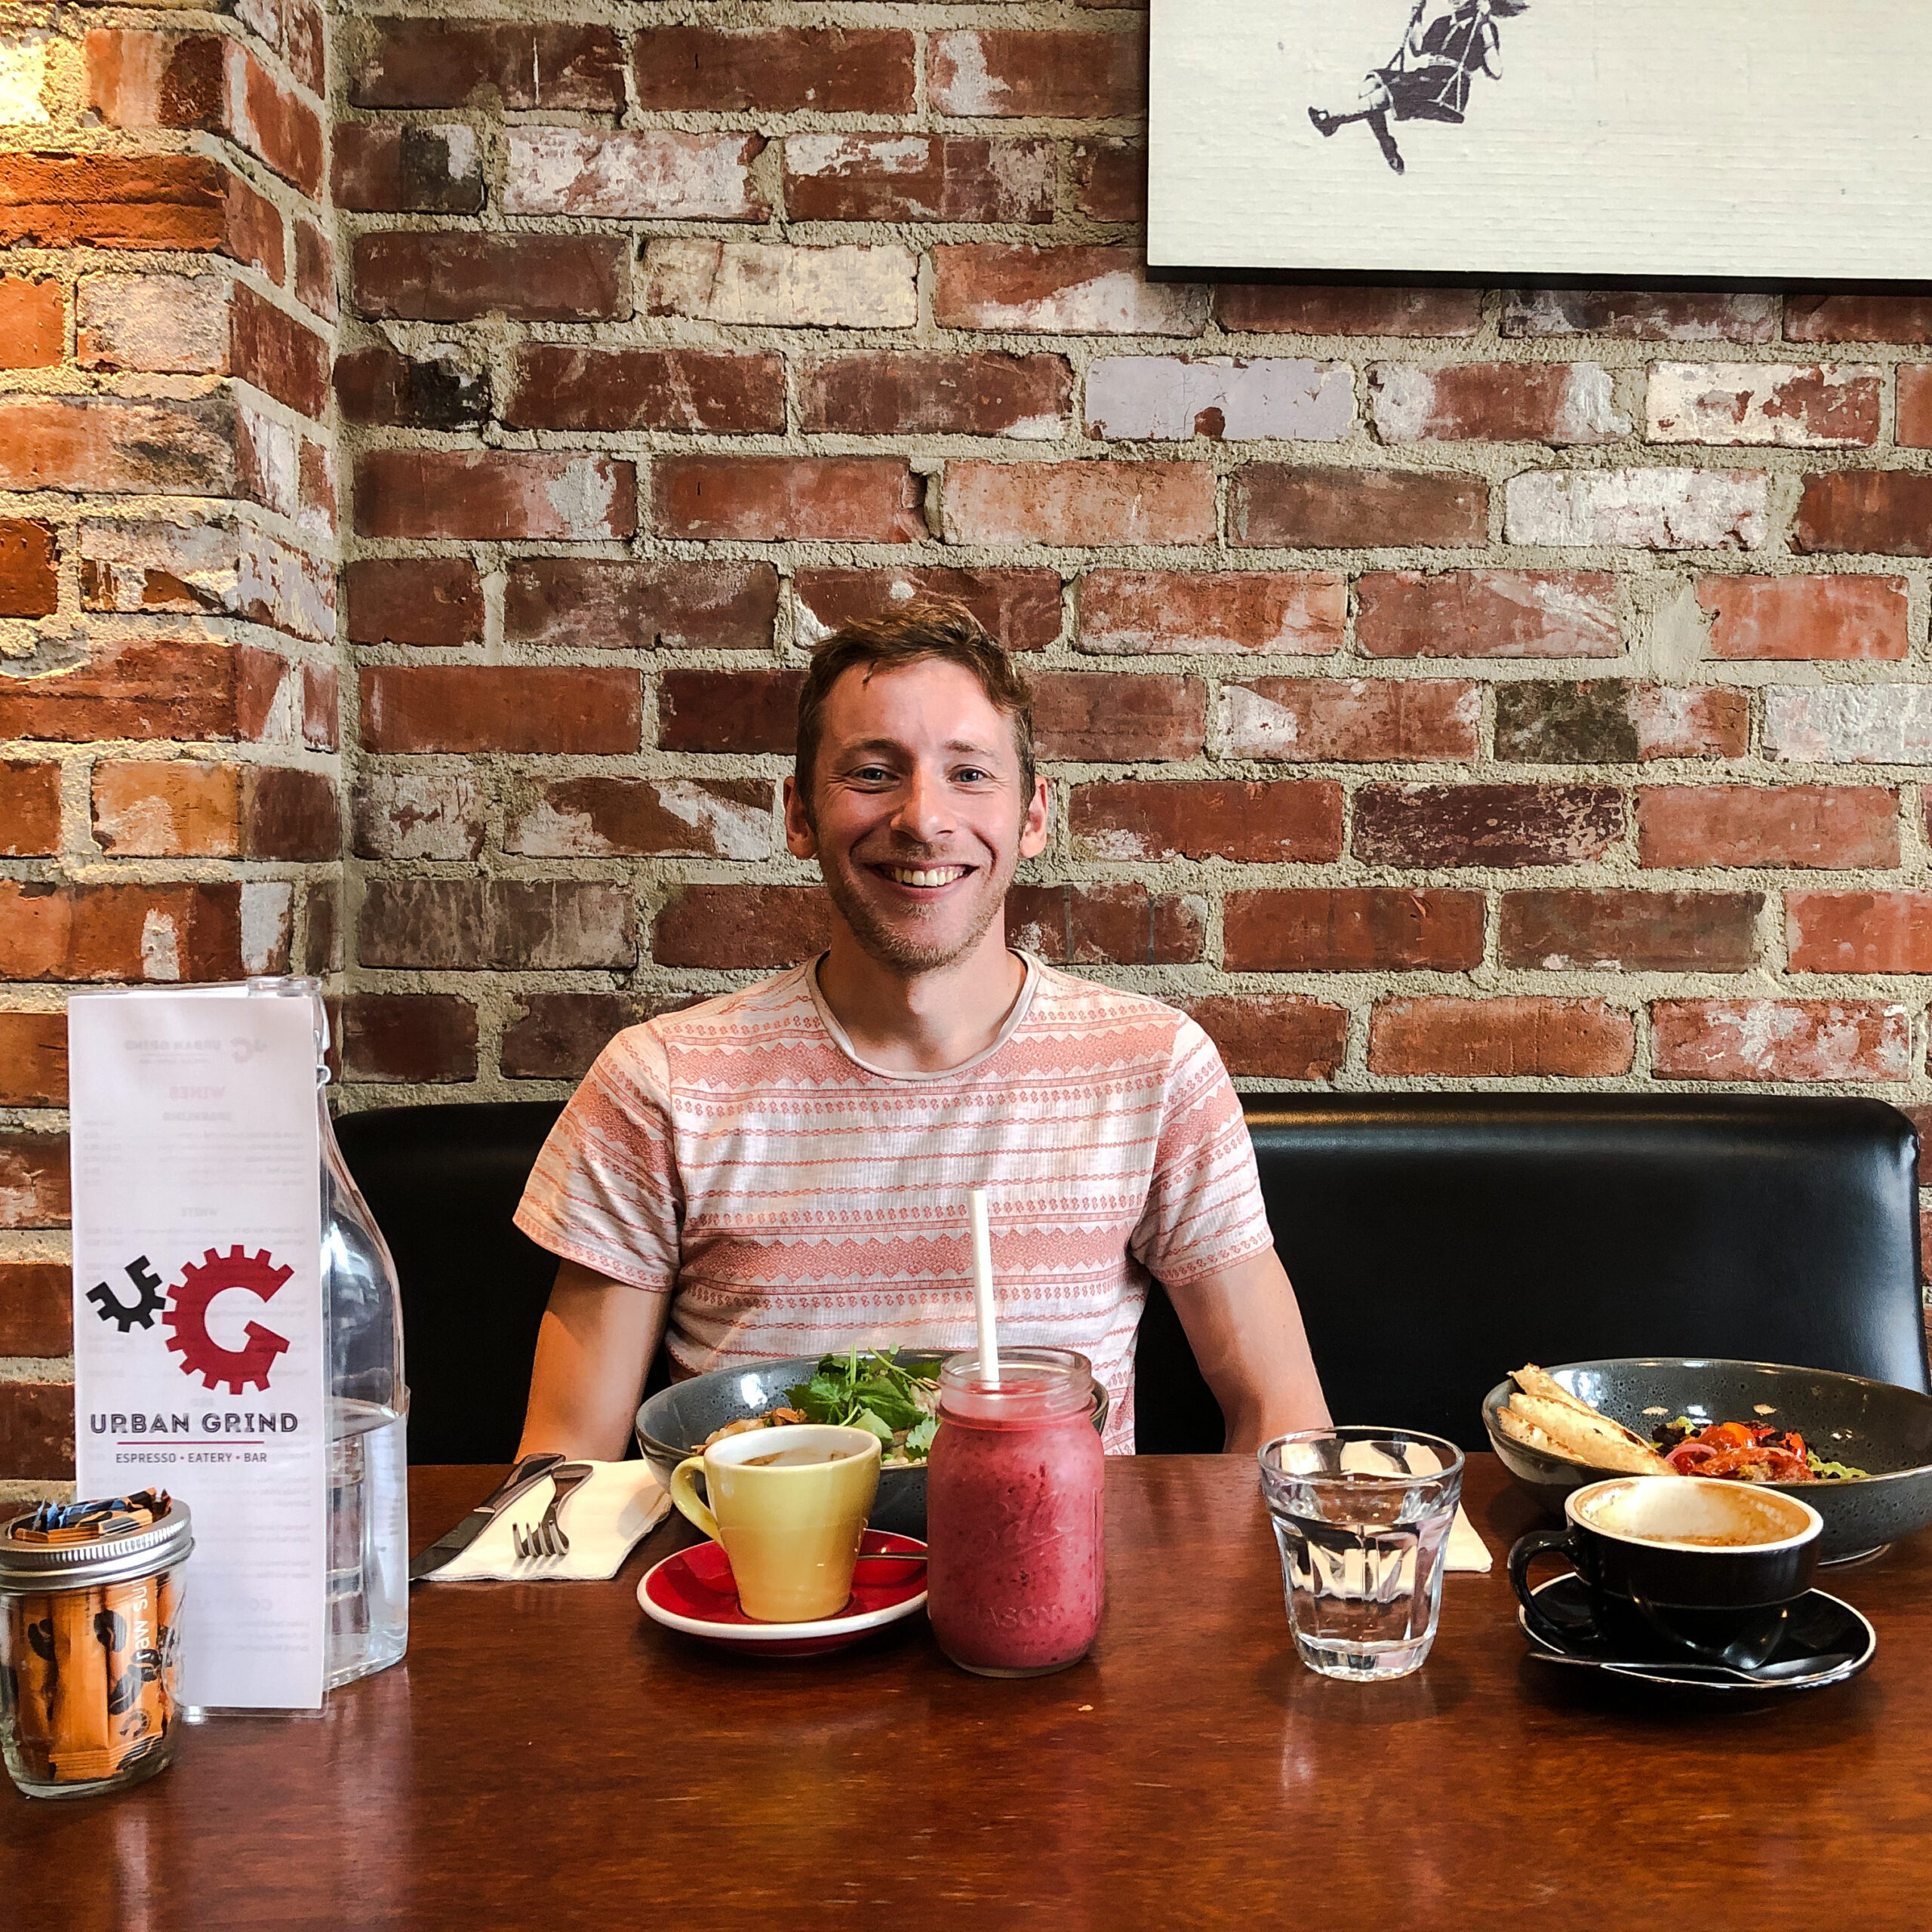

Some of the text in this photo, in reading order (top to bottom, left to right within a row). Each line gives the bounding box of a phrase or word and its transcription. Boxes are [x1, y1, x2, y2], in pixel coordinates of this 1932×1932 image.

[90, 1412, 298, 1434] URBAN GRIND
[115, 1452, 267, 1463] ESPRESSO EATERY BAR
[134, 1620, 151, 1661] raw
